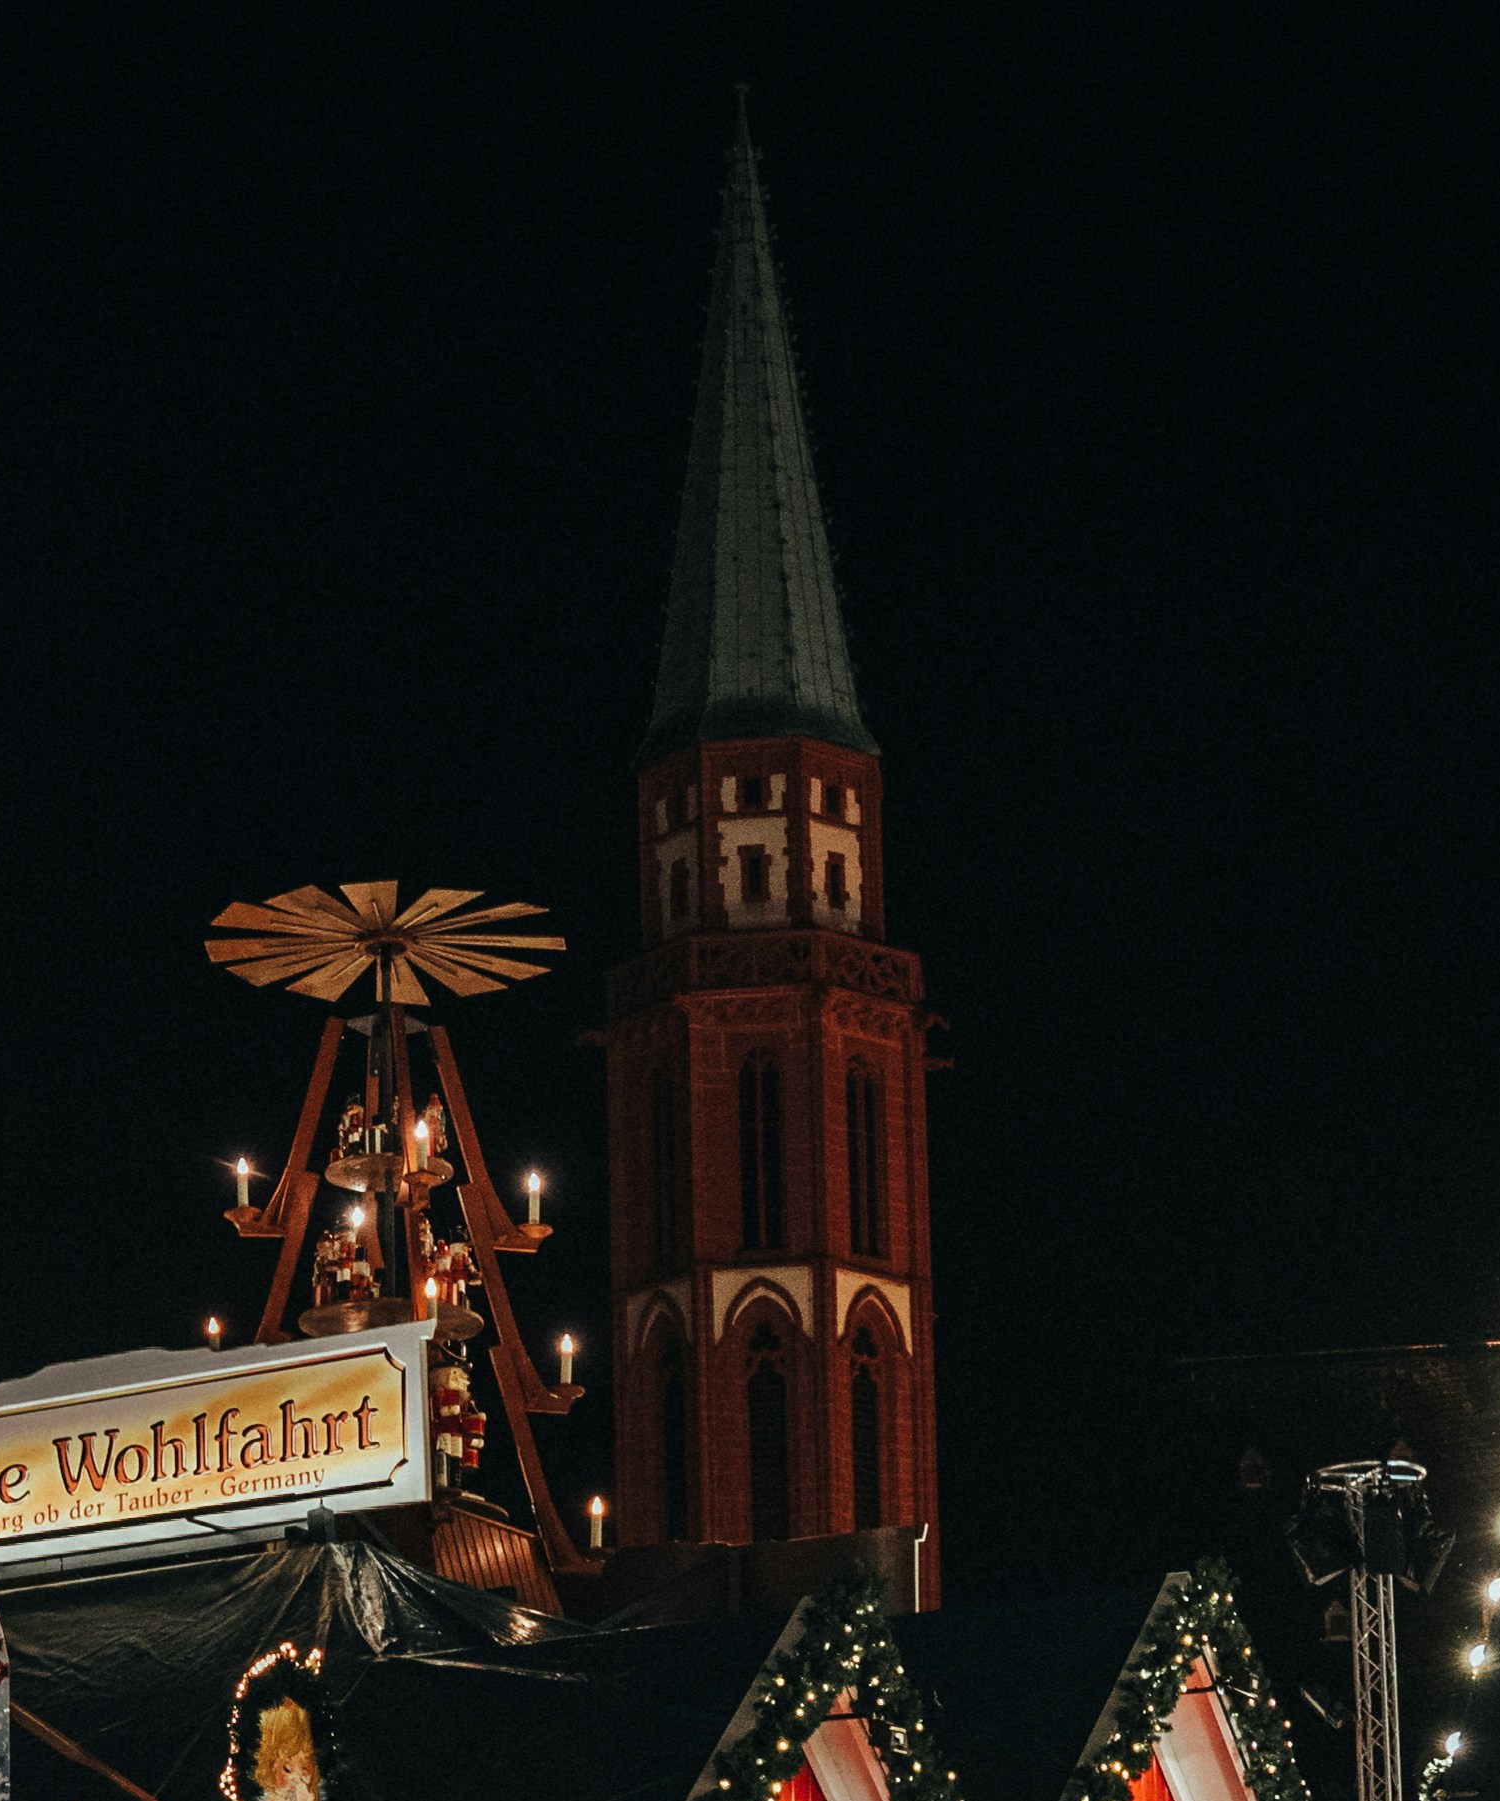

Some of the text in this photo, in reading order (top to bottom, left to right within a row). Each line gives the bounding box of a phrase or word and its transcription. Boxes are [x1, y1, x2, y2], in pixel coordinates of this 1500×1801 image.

[52, 1395, 381, 1497] Wohlfahrt
[33, 1505, 60, 1526] ob
[69, 1498, 106, 1520] der
[114, 1486, 195, 1514] Tauber
[219, 1468, 326, 1498] Germany
